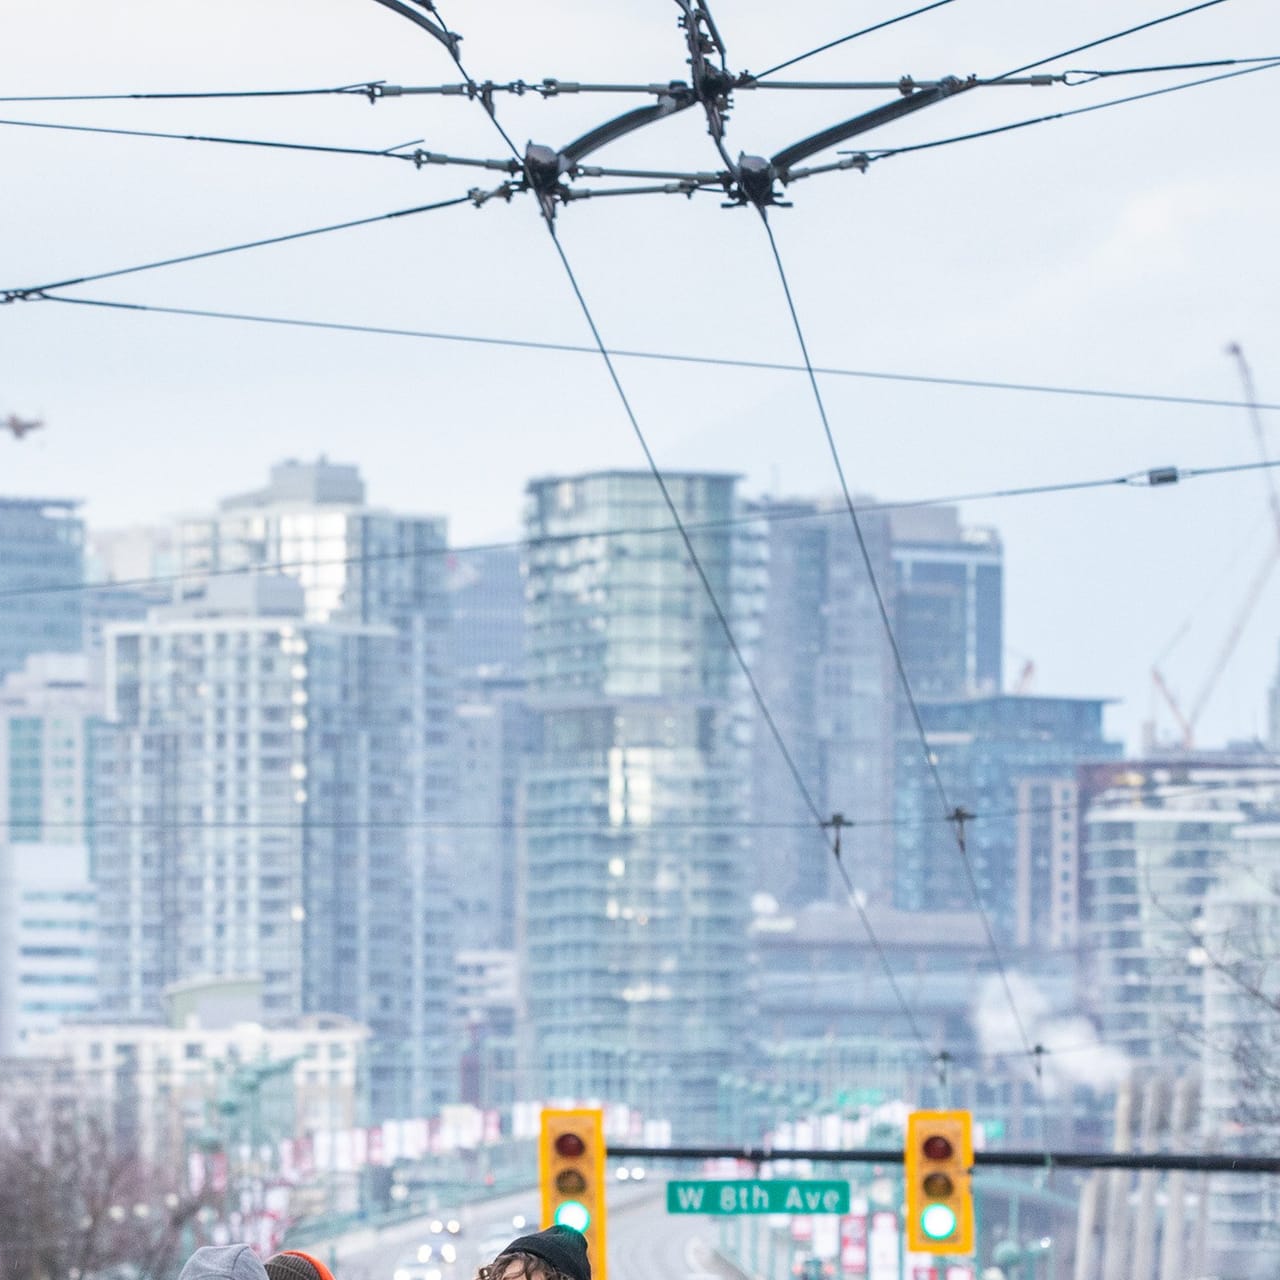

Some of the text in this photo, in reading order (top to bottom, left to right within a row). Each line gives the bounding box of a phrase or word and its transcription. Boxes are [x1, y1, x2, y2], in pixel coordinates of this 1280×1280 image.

[677, 1184, 840, 1212] W 8th Ave
